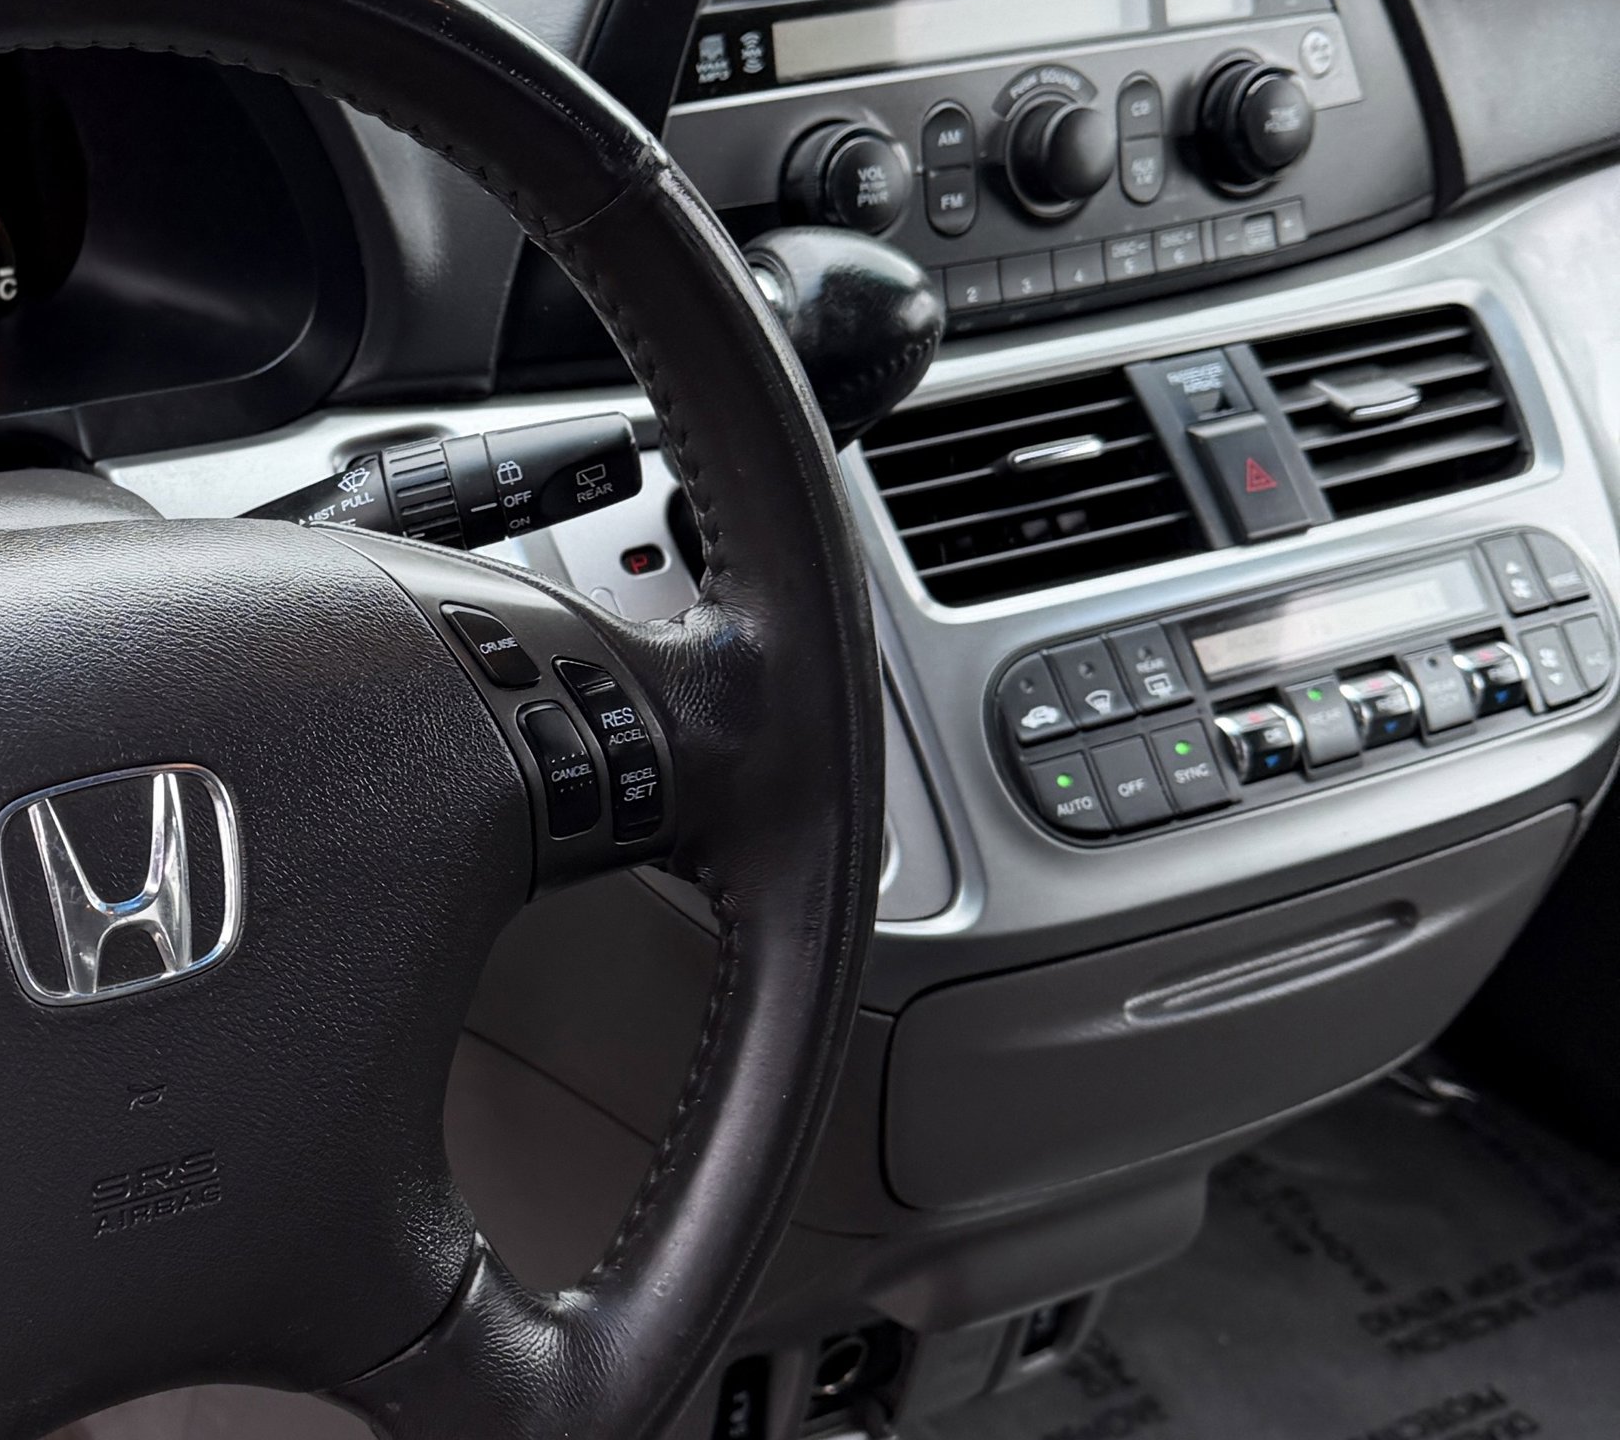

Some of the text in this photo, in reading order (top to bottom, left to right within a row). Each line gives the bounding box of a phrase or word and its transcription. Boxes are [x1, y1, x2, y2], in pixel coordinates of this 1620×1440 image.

[1131, 101, 1151, 116] CD
[938, 131, 962, 146] AM
[857, 166, 886, 181] VOL
[940, 194, 964, 210] FM
[966, 287, 979, 303] 2
[341, 492, 374, 511] PULL
[503, 490, 532, 509] OFF
[577, 483, 613, 504] REAR
[509, 516, 530, 530] ON
[631, 553, 648, 574] P
[480, 637, 518, 655] CRUISE
[1136, 658, 1165, 673] REAR
[600, 707, 635, 730] RES
[608, 729, 645, 746] ACCEL
[551, 763, 592, 782] CANCEL
[620, 767, 656, 785] DECEL
[1174, 762, 1210, 784] SYNC
[624, 782, 657, 802] SET
[1118, 777, 1145, 798] OFF
[1057, 795, 1093, 817] AUTO
[92, 1150, 217, 1208] SRS
[93, 1184, 222, 1239] AIRBAG
